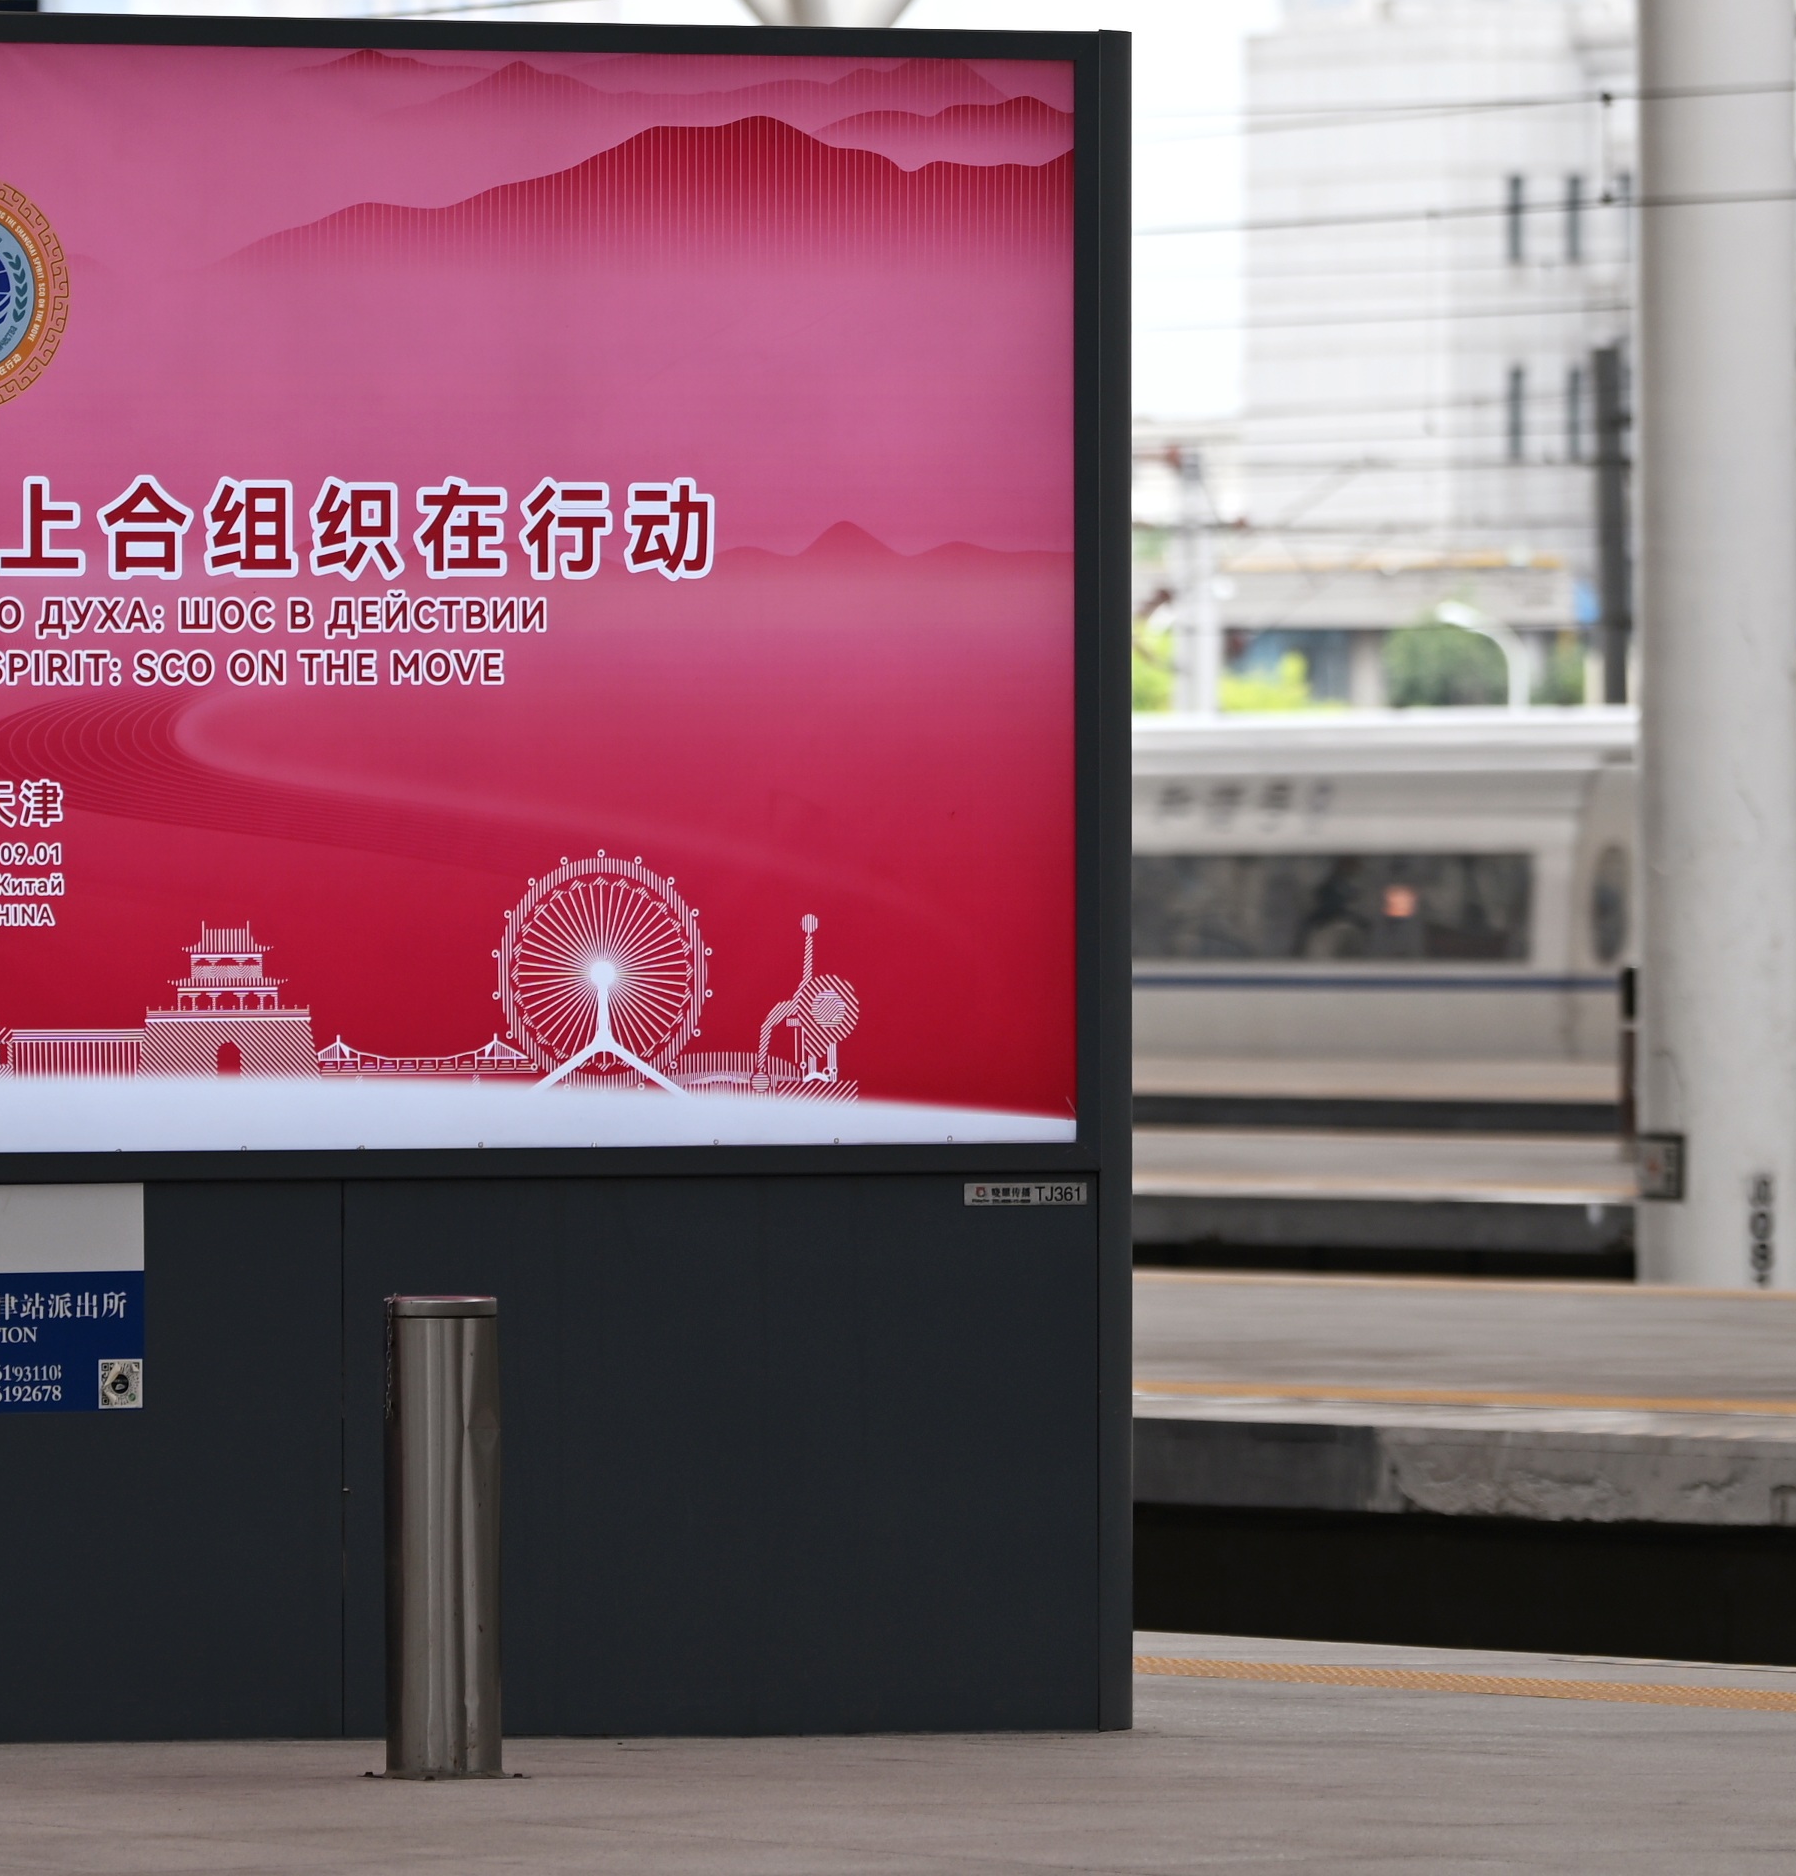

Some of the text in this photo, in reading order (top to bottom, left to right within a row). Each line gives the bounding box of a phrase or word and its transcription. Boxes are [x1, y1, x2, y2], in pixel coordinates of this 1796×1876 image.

[36, 595, 166, 638] ДУХА:
[177, 595, 274, 633] ШОС
[287, 596, 314, 632] В
[326, 589, 548, 637] ДЕЙСТВИИ
[132, 650, 215, 686] SCO
[226, 650, 289, 686] ON
[299, 650, 379, 686] THE
[390, 649, 506, 686] MOVE
[1034, 1185, 1081, 1202] TJ361
